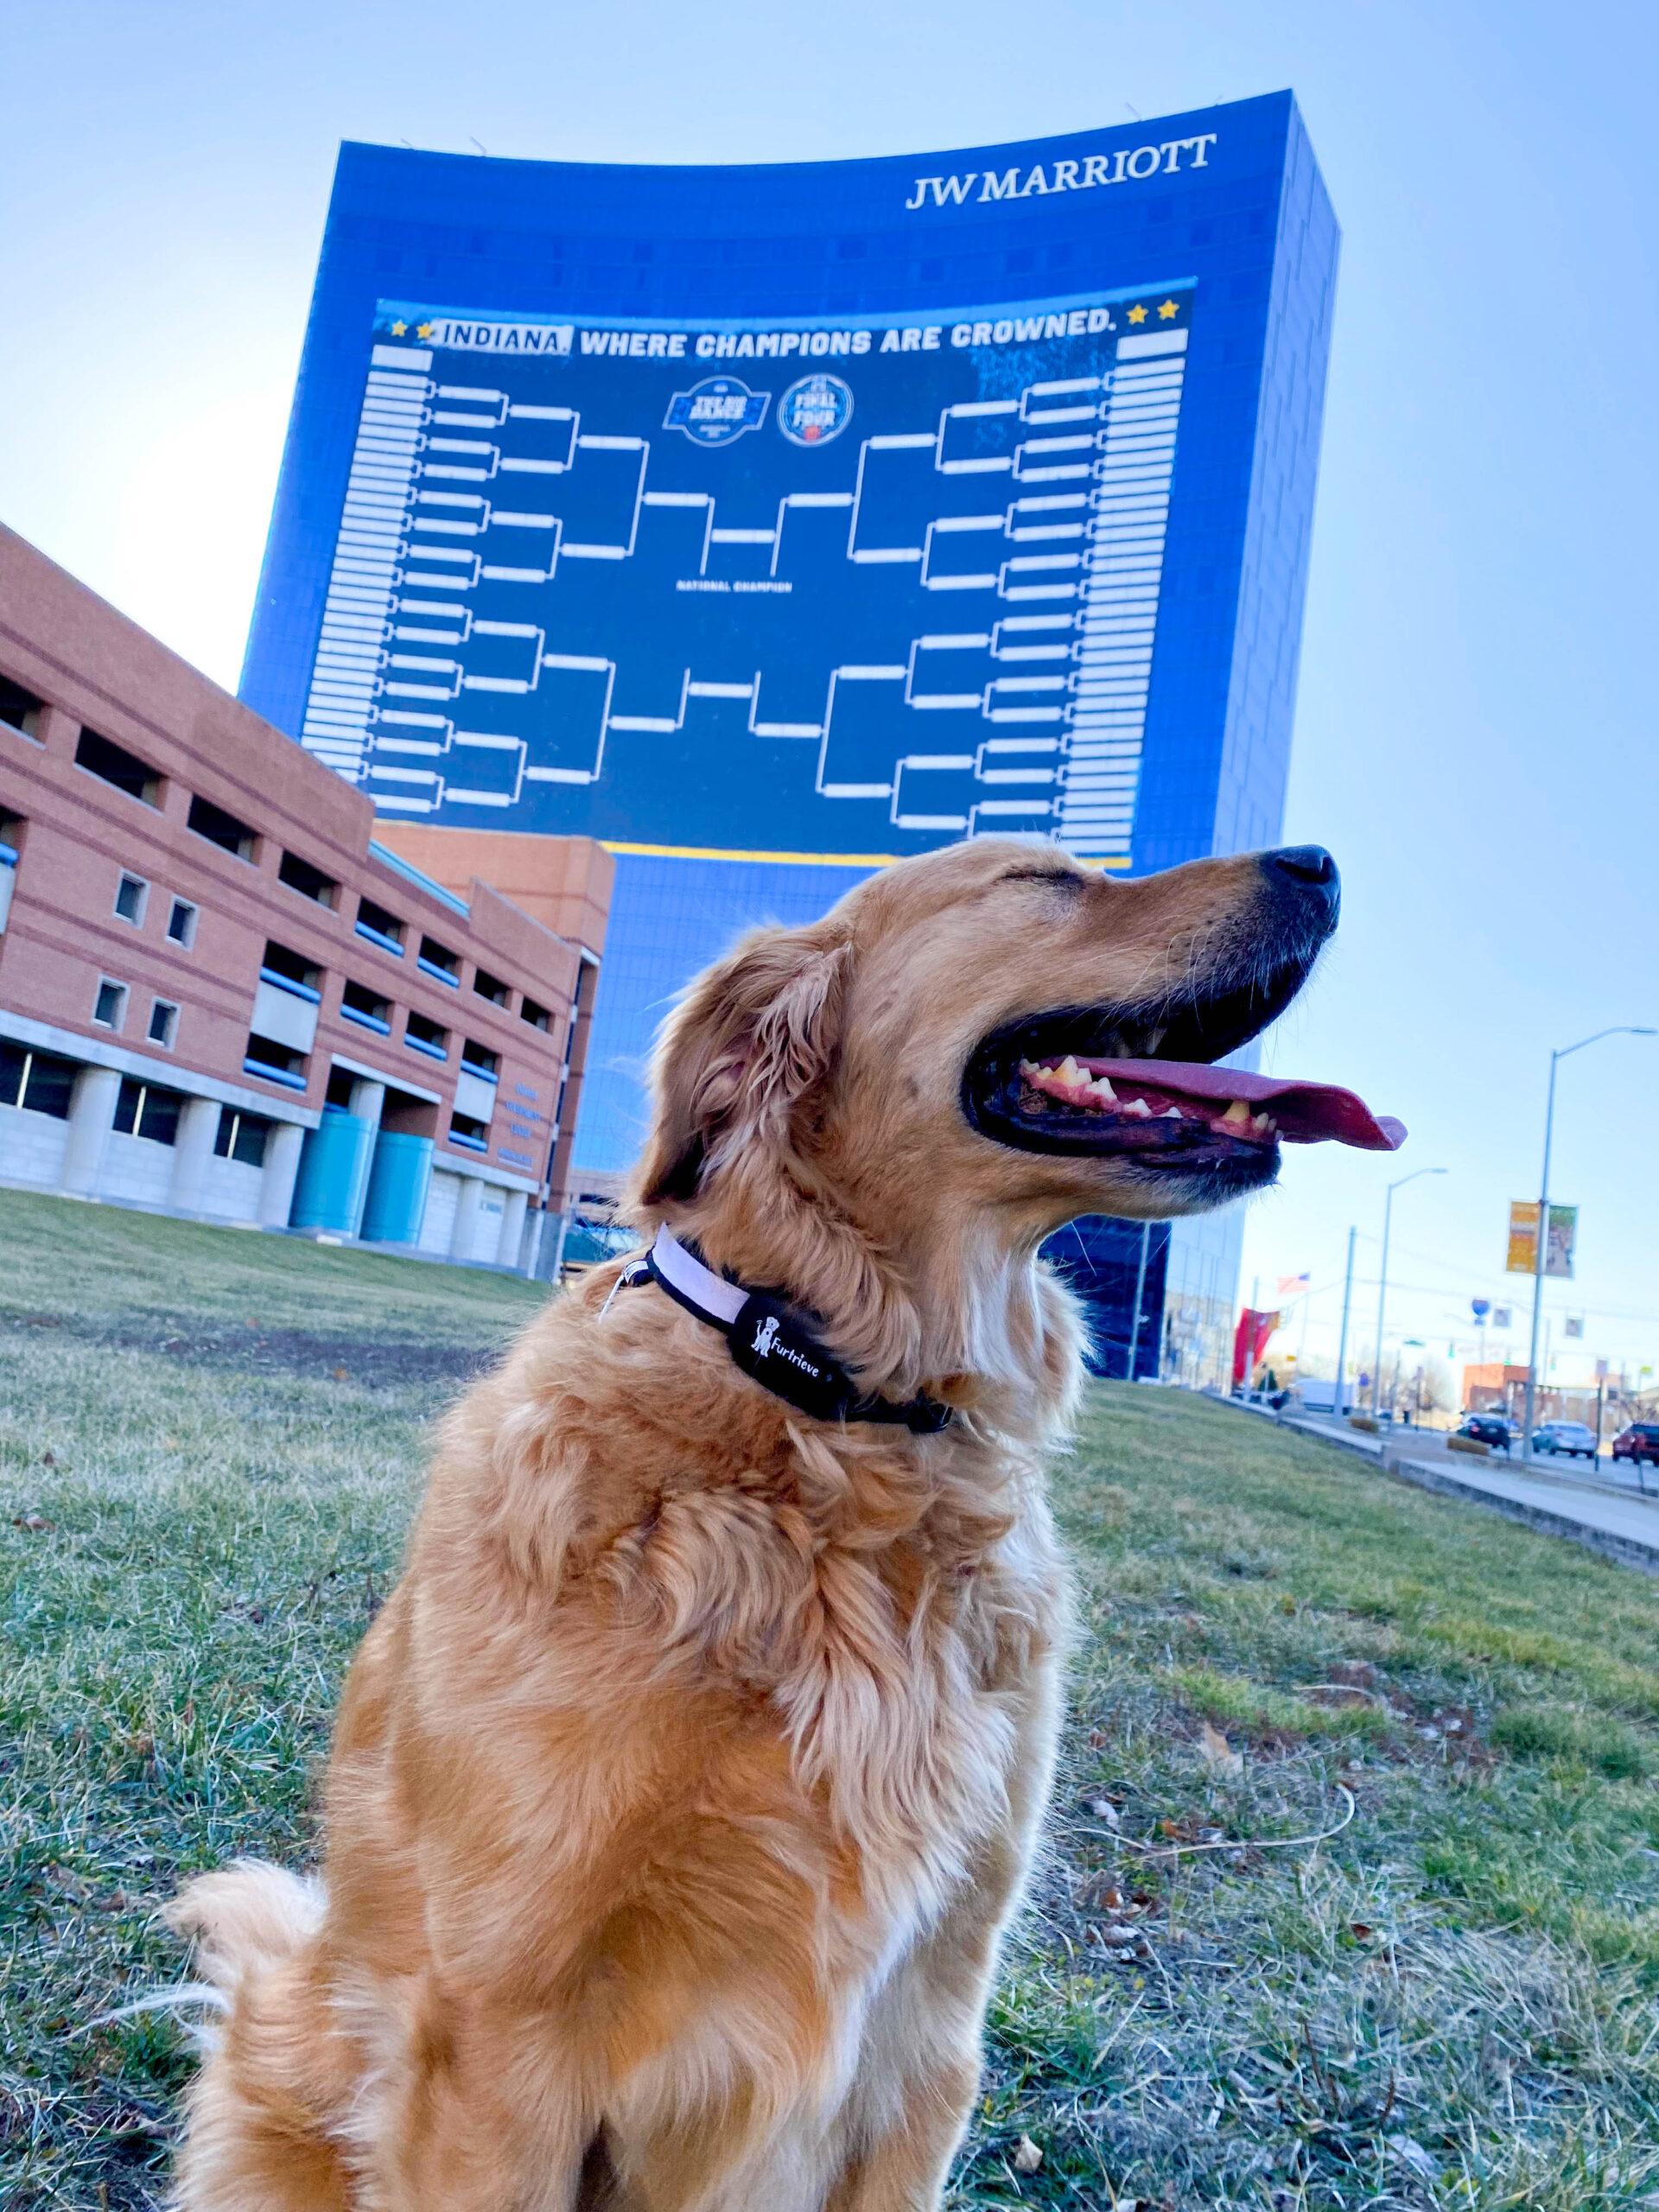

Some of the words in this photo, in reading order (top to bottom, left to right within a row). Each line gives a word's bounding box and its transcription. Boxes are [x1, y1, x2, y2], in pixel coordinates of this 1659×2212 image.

[906, 174, 977, 209] JW
[976, 133, 1217, 202] MARRIOTT
[580, 331, 688, 359] WHERE
[695, 332, 872, 359] CHAMPIONS
[879, 326, 943, 353] ARE
[950, 308, 1117, 348] CROWNED.
[676, 579, 731, 593] NATIONAL
[733, 581, 793, 594] CHAMPION
[771, 1337, 819, 1377] Furtrieve
